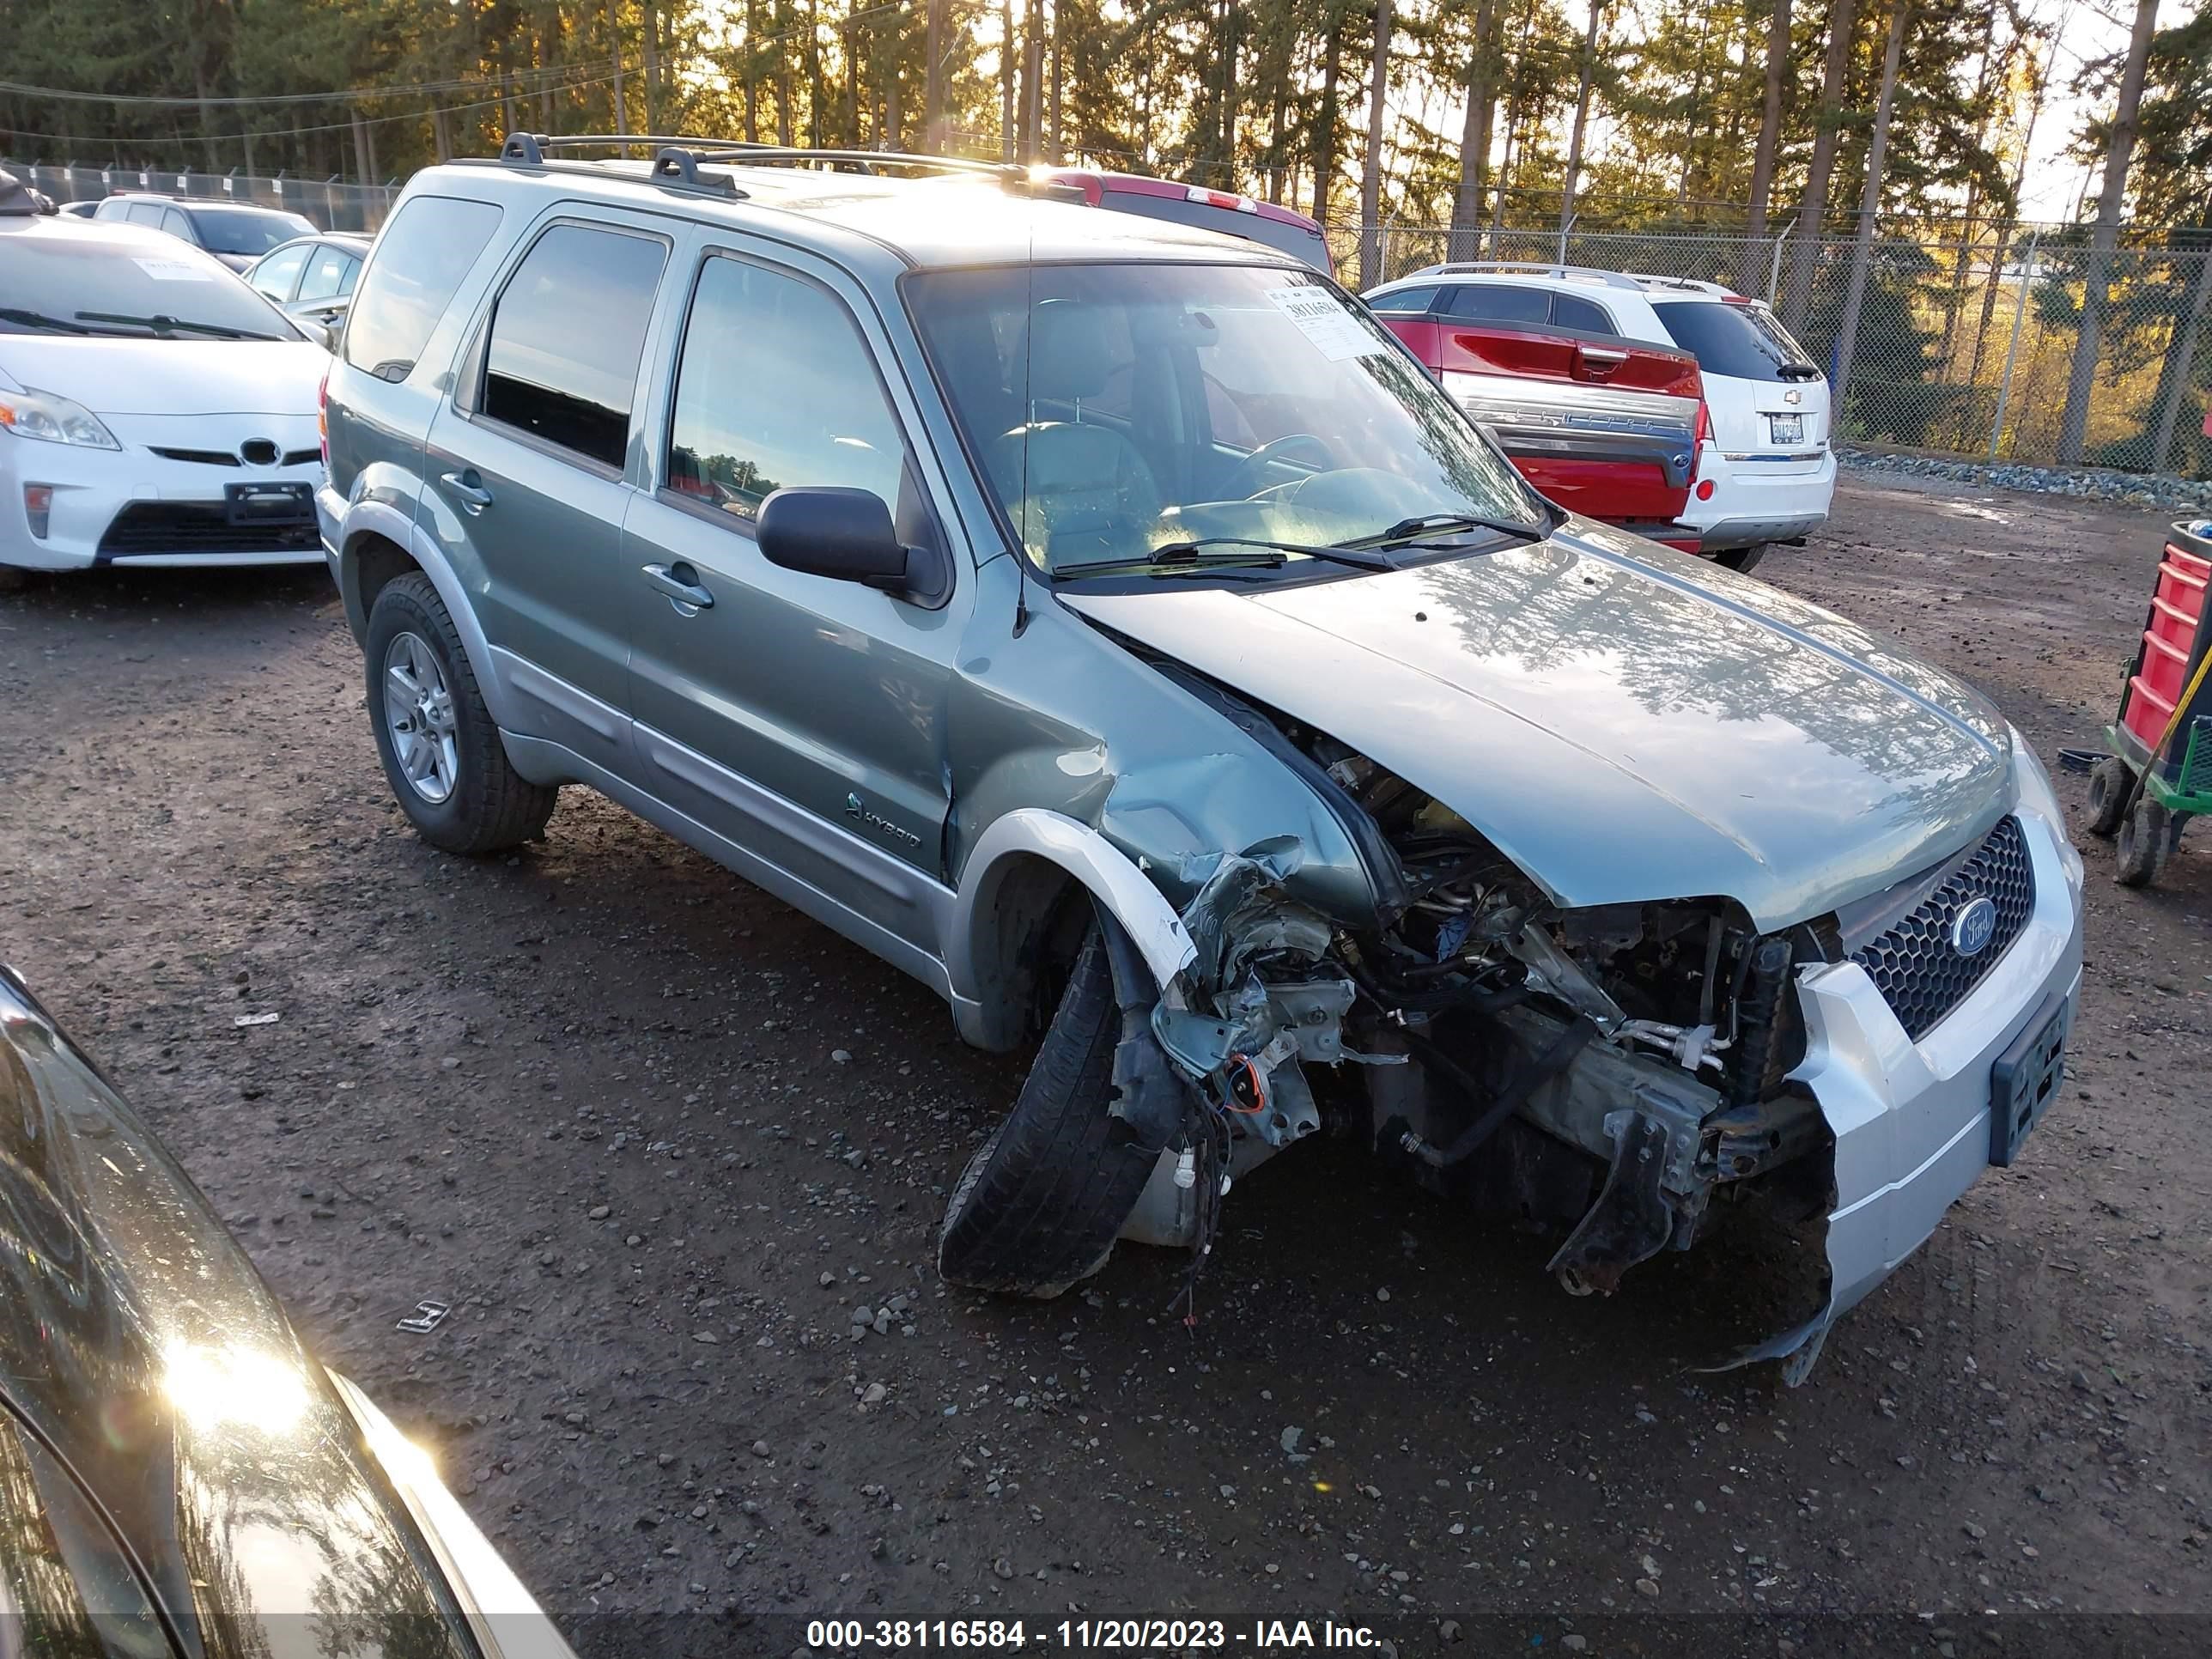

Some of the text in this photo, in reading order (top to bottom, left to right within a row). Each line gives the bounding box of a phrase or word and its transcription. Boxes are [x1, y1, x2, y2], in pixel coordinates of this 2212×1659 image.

[1286, 301, 1342, 318] 38116584
[1515, 408, 1654, 431] LIMITED
[1966, 909, 1990, 945] Ford
